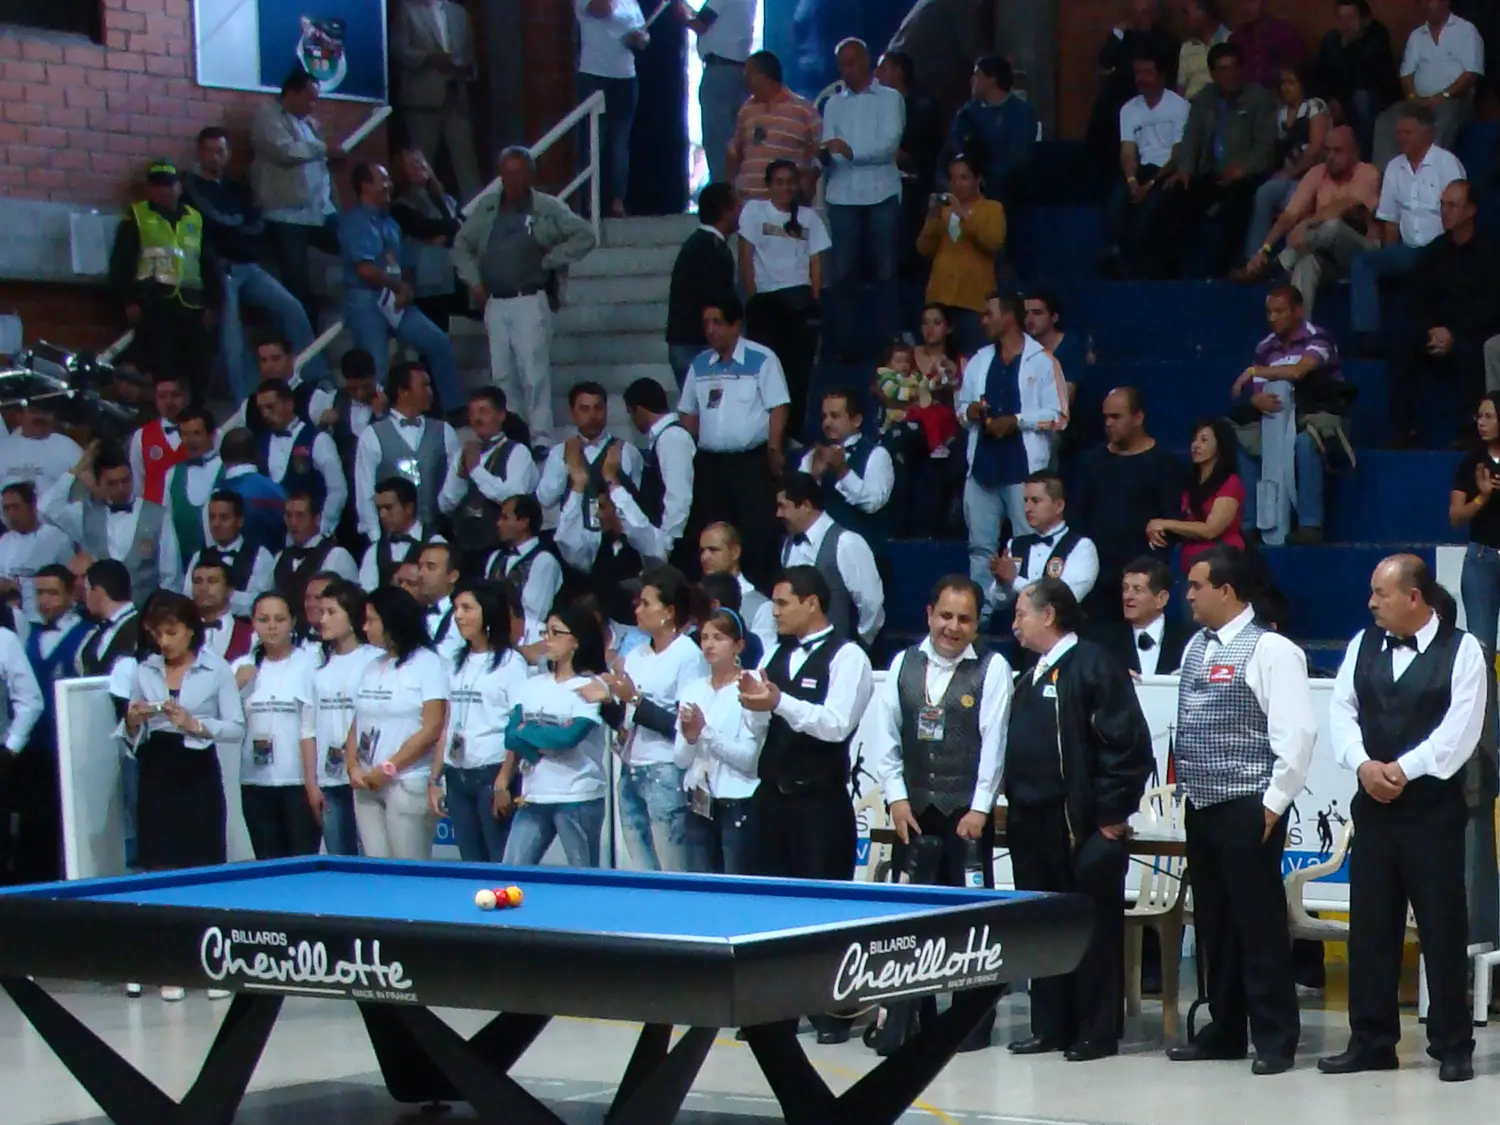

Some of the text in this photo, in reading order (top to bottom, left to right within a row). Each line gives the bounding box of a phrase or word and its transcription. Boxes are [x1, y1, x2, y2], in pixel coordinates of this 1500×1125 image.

[201, 926, 413, 989] Chevillotte
[231, 929, 288, 946] BILLARDS
[869, 935, 917, 955] BILLARDS
[833, 924, 1004, 1001] Chevillotte
